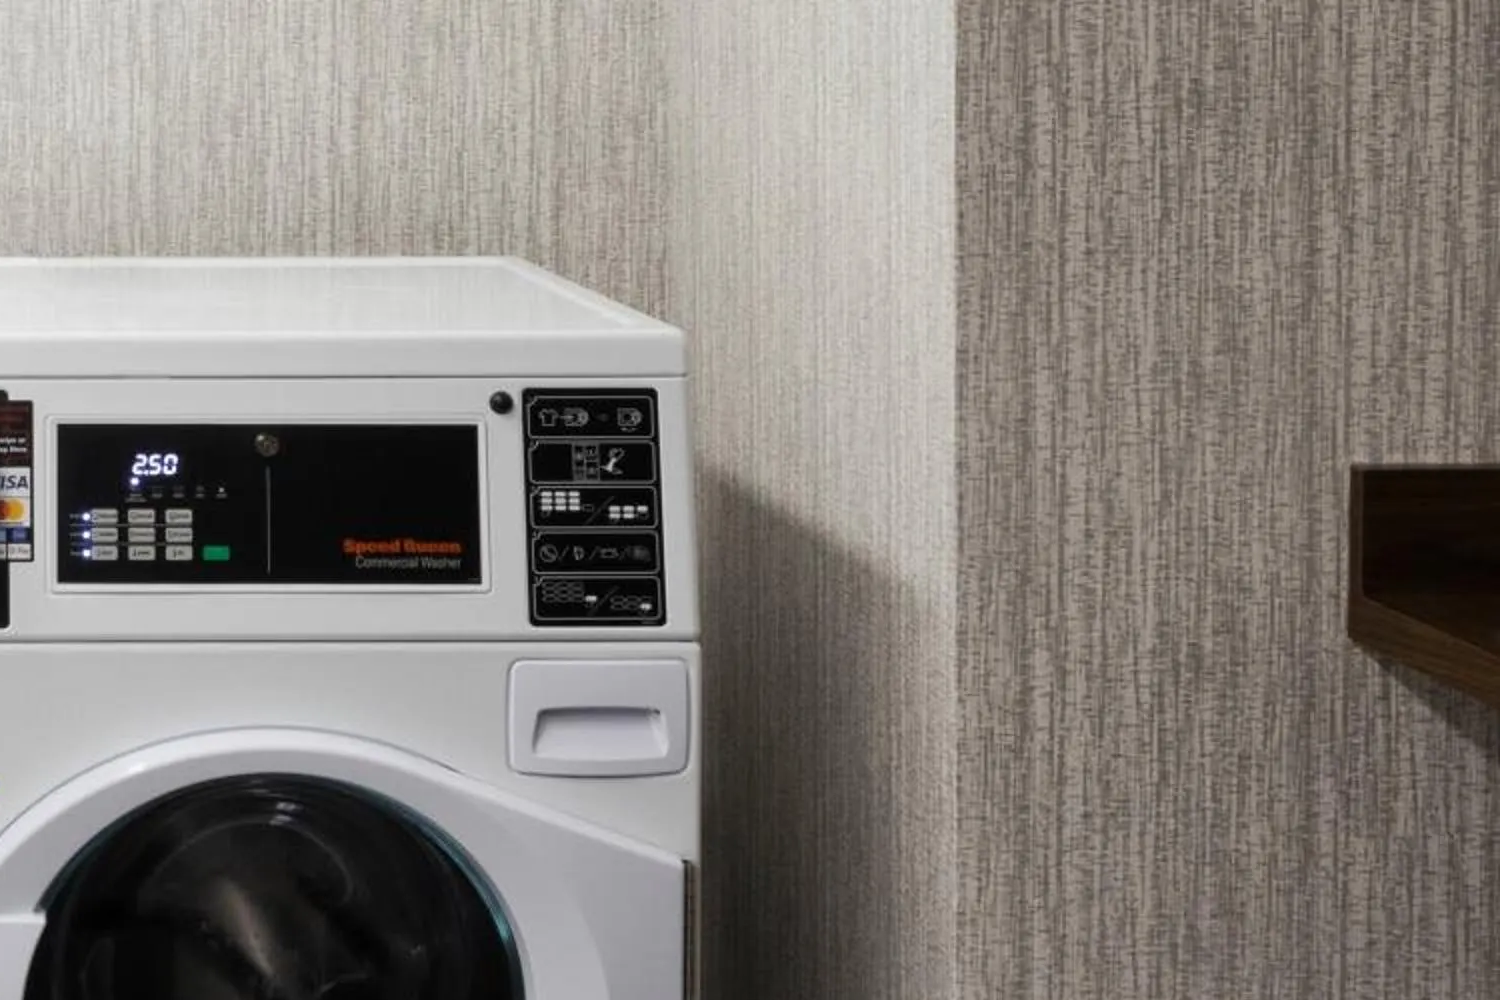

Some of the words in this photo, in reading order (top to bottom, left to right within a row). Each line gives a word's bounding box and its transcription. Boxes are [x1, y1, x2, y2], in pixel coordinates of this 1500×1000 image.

[342, 538, 401, 556] Speed
[402, 538, 462, 553] Queen
[355, 556, 419, 569] Commercial
[420, 556, 461, 569] Washer
